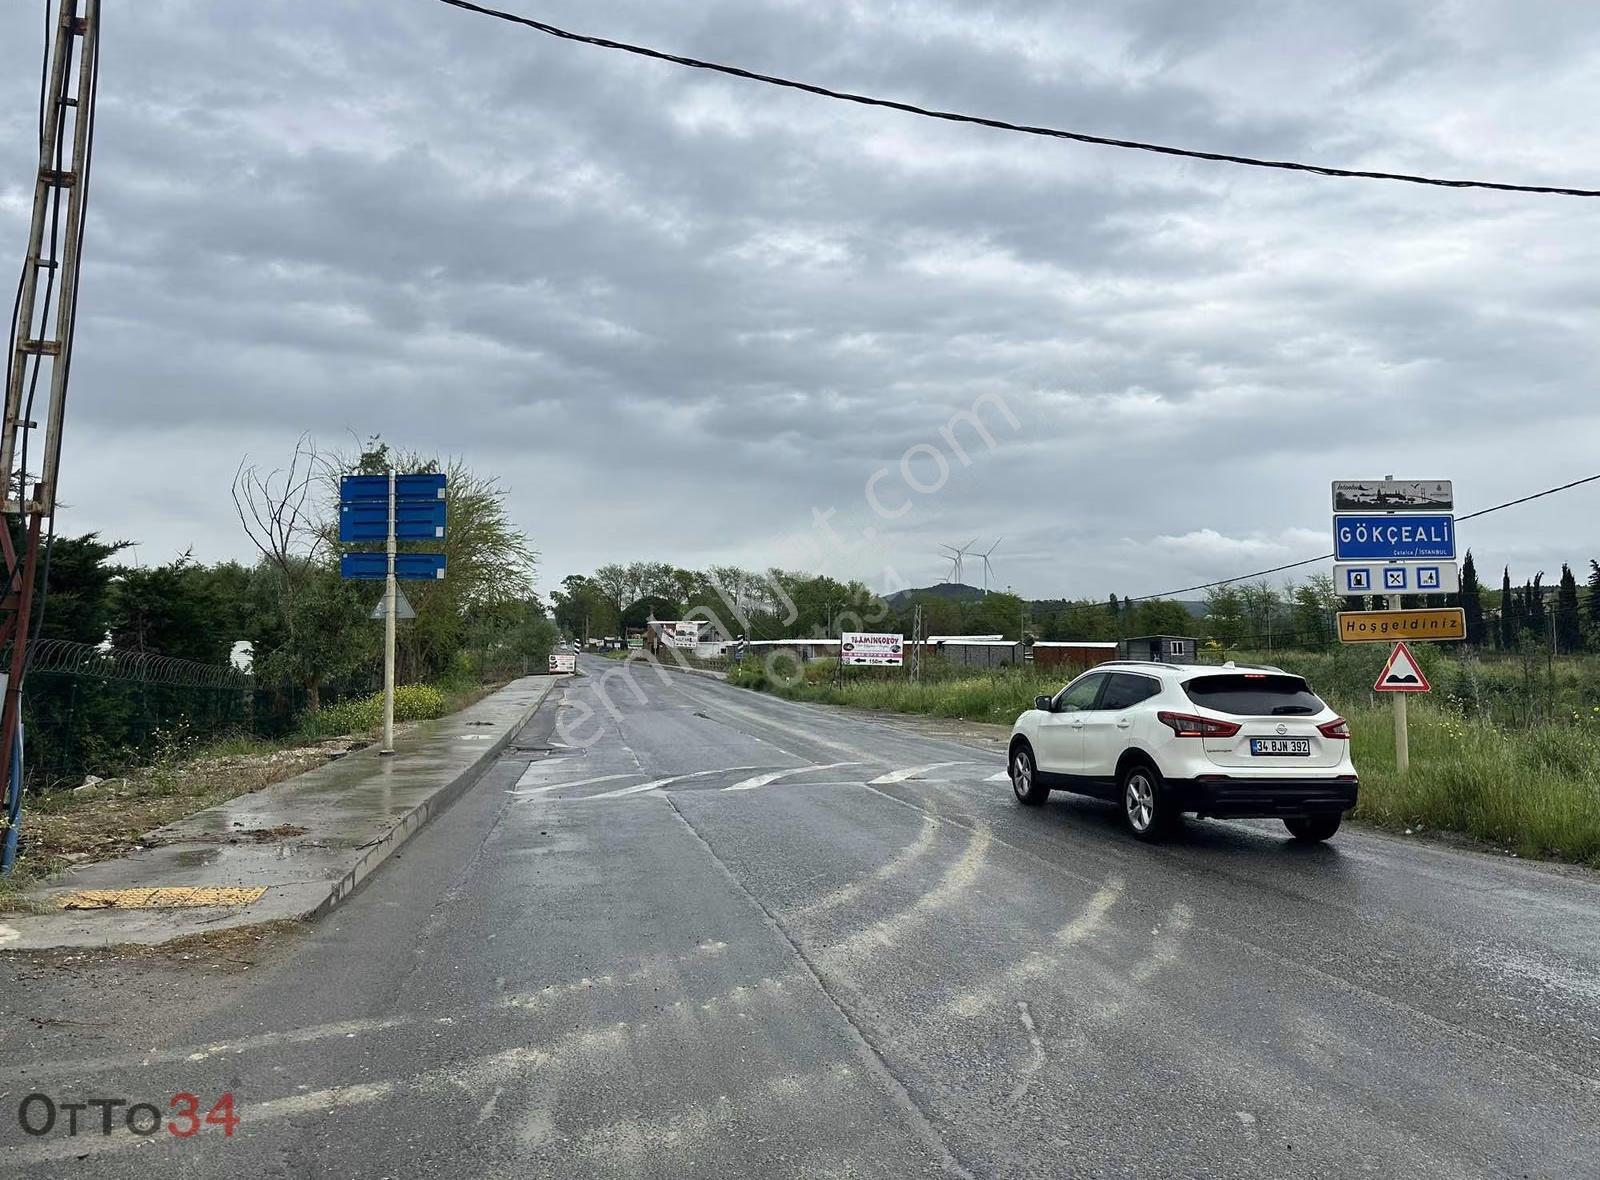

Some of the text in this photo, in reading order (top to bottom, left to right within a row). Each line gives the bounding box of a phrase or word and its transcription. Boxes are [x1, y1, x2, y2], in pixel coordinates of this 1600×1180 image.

[1340, 522, 1449, 545] GÖKÇEALİ
[1346, 618, 1457, 634] Hoşgeldiniz
[1257, 741, 1308, 752] 34 BJN 392
